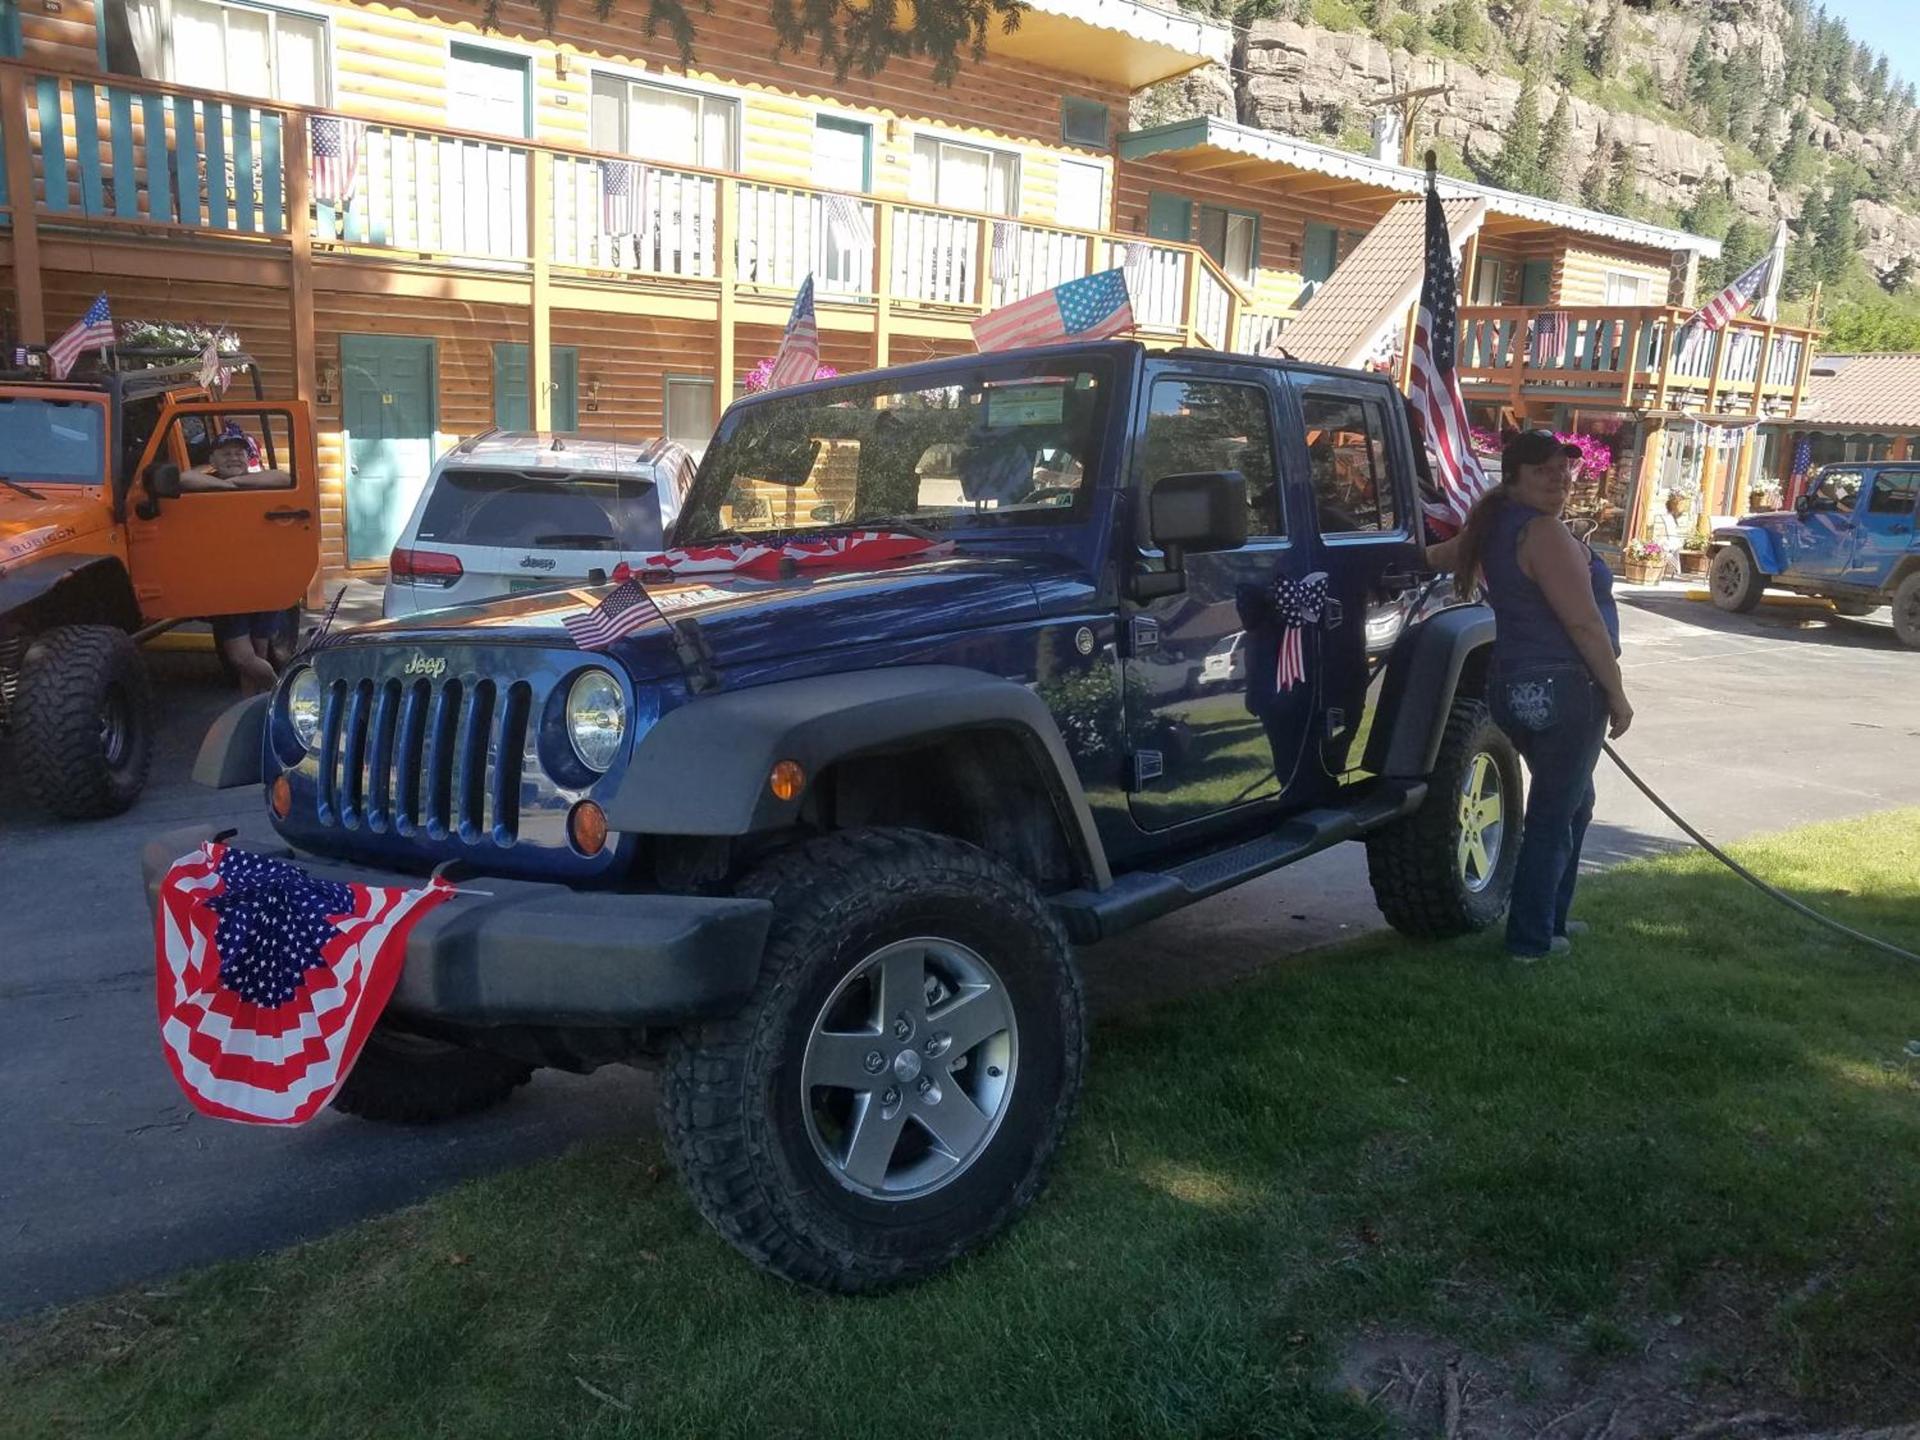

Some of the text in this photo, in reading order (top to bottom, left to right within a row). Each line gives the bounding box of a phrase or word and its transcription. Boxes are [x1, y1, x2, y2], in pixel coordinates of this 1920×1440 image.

[10, 528, 76, 553] RUBICON
[520, 555, 556, 571] Jeep
[405, 653, 446, 678] Jeep
